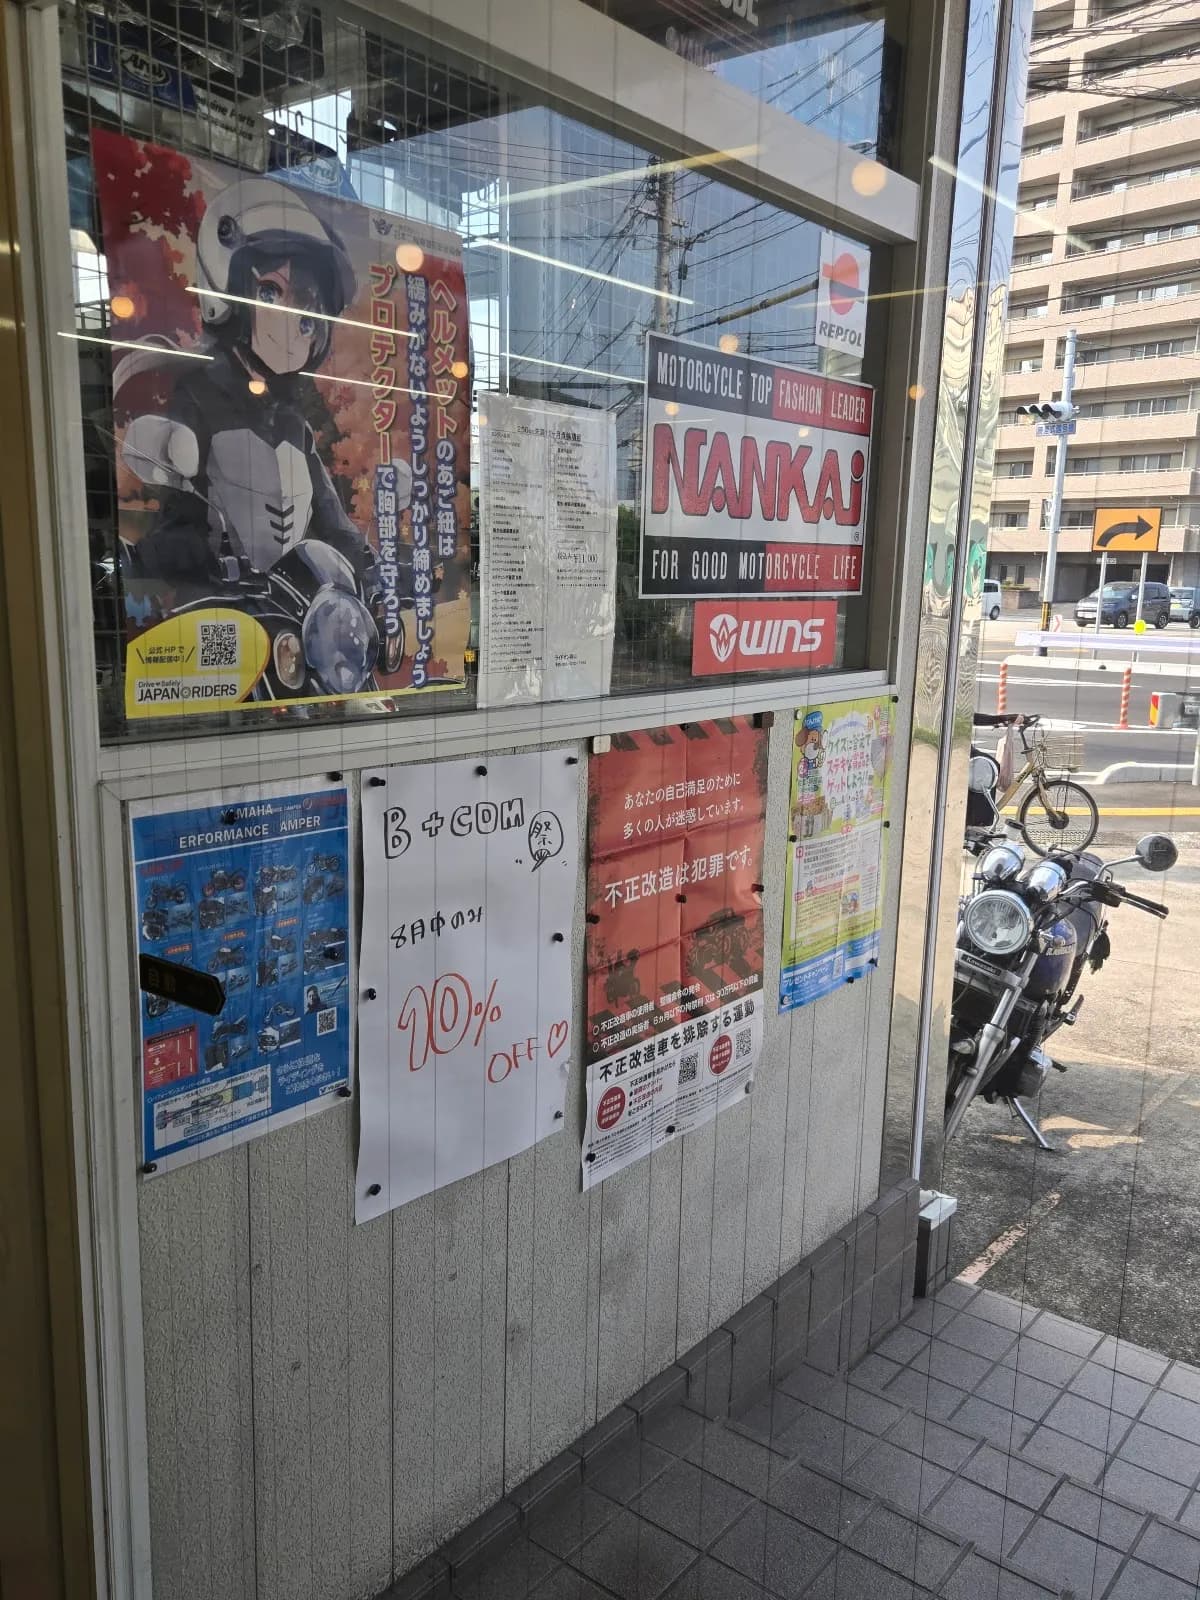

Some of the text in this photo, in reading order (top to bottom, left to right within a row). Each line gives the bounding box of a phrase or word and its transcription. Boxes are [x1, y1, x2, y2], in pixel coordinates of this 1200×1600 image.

[818, 320, 864, 348] REPSOL
[657, 351, 865, 424] MOTORCYCLE TOP FASHION LEADER
[431, 279, 458, 557] ヘルメットのあご紐は
[370, 264, 399, 634] プロテクターで胸部を守ろう
[406, 275, 432, 686] 緩みがないようしっかり締めましょう
[651, 549, 857, 580] FOR GOOD MOTORCYCLE LIFE
[138, 680, 181, 689] Drive Safely
[138, 684, 238, 702] JAPAN RIDERS
[220, 803, 274, 820] YMAHA
[624, 773, 741, 810] あなたの自己満足のために
[384, 798, 524, 859] B+COM
[623, 797, 744, 840] 多くの人が迷惑しています。
[605, 845, 753, 909] 不正改造は犯罪です。
[390, 907, 483, 949] 8月中のみ
[966, 956, 998, 974] Kawasaki
[398, 973, 502, 1072] 10%
[599, 999, 755, 1083] 不正改造車を排除する運動
[488, 1037, 542, 1083] OFF
